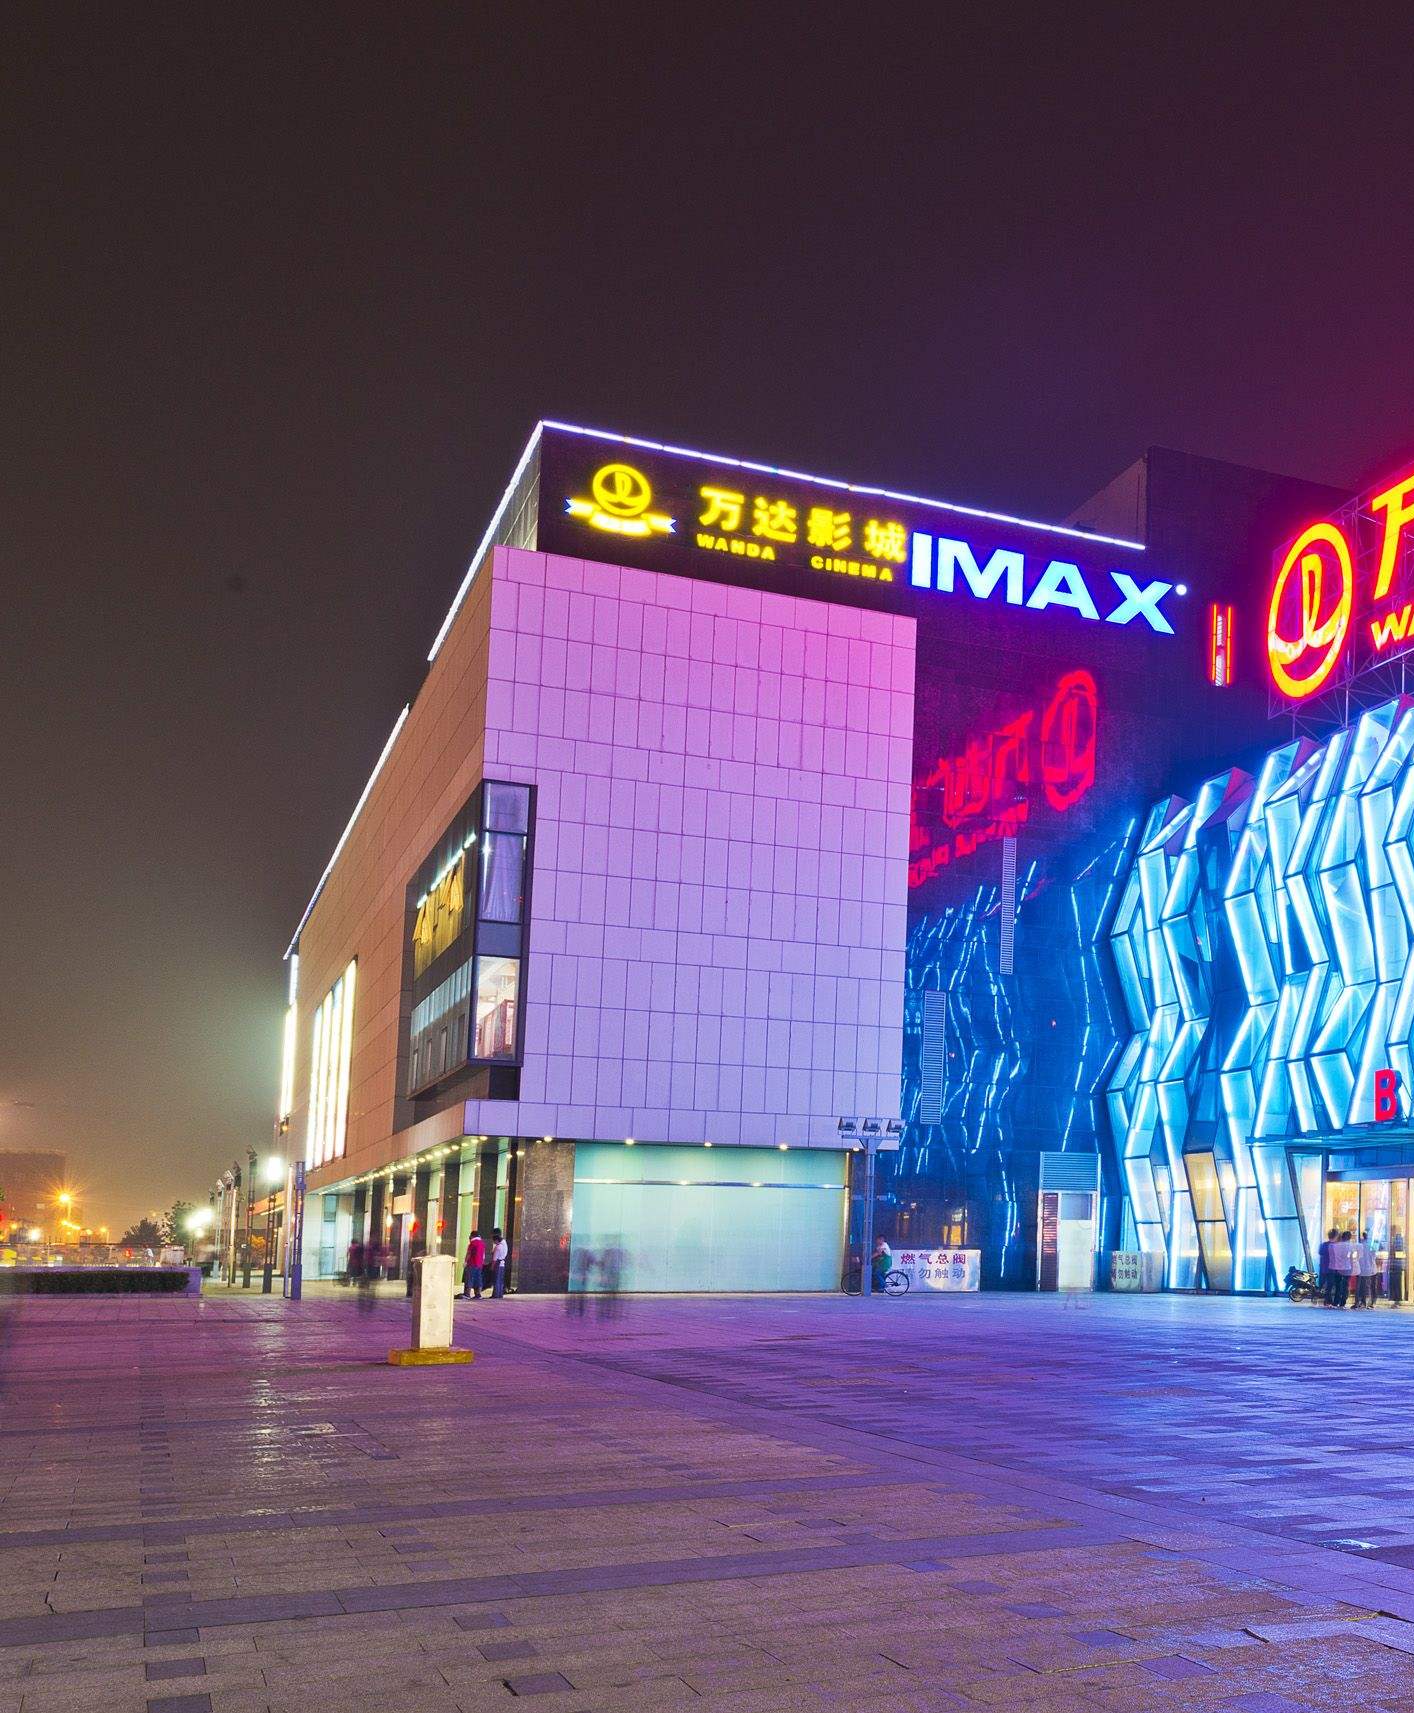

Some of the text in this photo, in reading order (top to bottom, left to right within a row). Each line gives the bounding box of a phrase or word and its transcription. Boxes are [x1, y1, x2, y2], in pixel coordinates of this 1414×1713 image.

[698, 486, 908, 564] 万达影城
[696, 533, 893, 583] WANDA CINEMA
[911, 531, 1175, 635] IMAX
[1374, 1069, 1399, 1122] B
[900, 1253, 967, 1265] 燃气总阀
